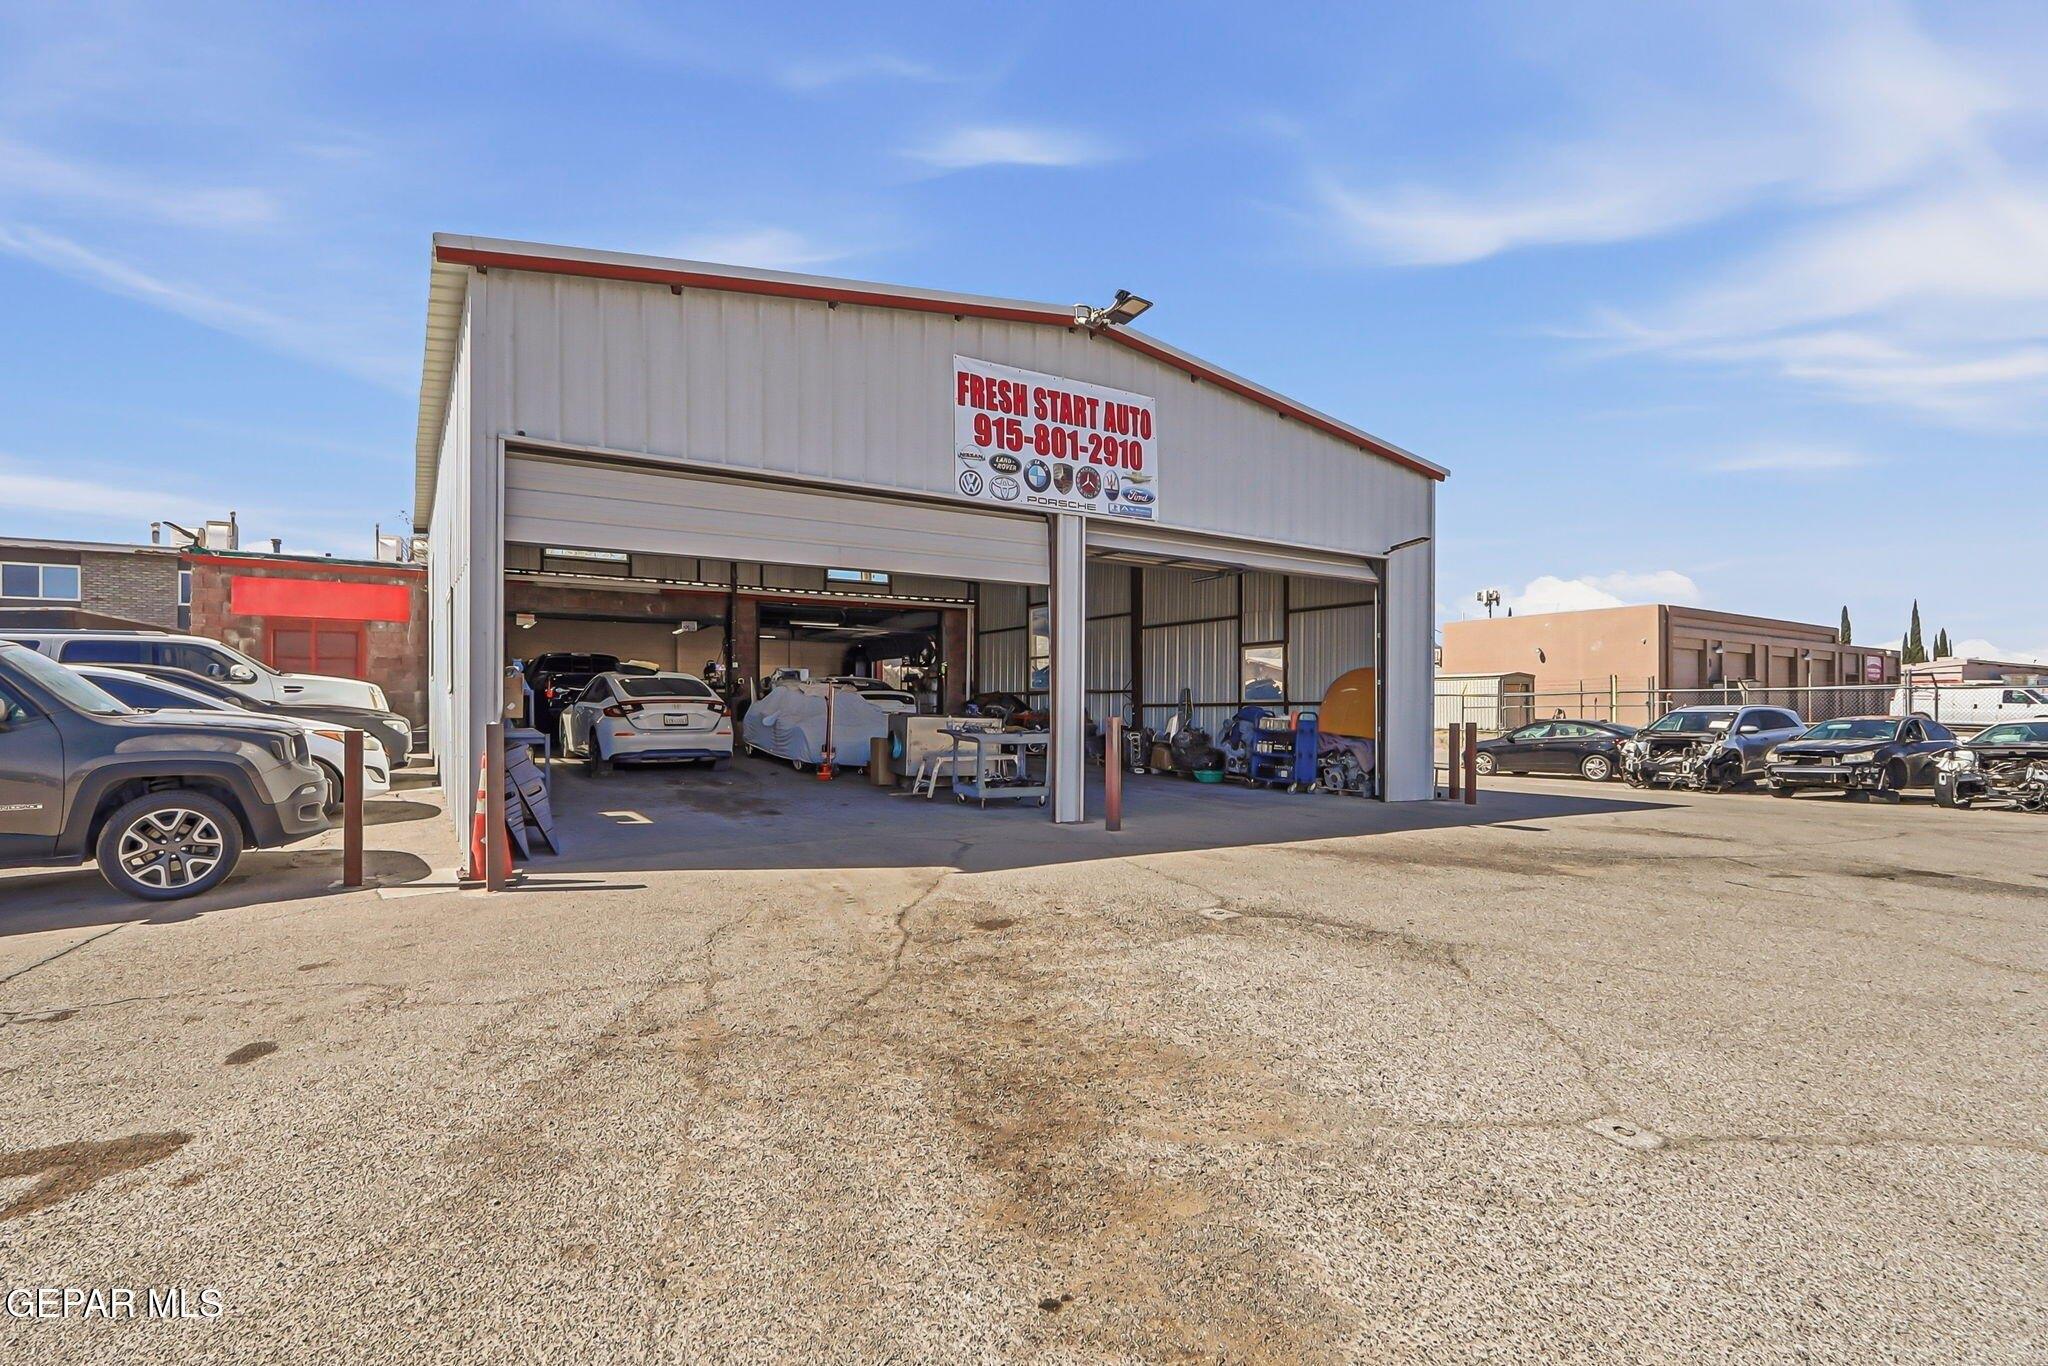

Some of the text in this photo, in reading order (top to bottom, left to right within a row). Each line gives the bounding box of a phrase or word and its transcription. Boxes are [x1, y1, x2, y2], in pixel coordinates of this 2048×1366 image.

[957, 371, 1152, 440] FRESH START AUTO
[973, 412, 1143, 471] 915-801-2910
[959, 451, 983, 460] NISSAN
[995, 456, 1012, 464] LAND
[996, 463, 1017, 472] ROVER
[1127, 489, 1149, 502] Ford
[1027, 495, 1097, 511] PORSCHE
